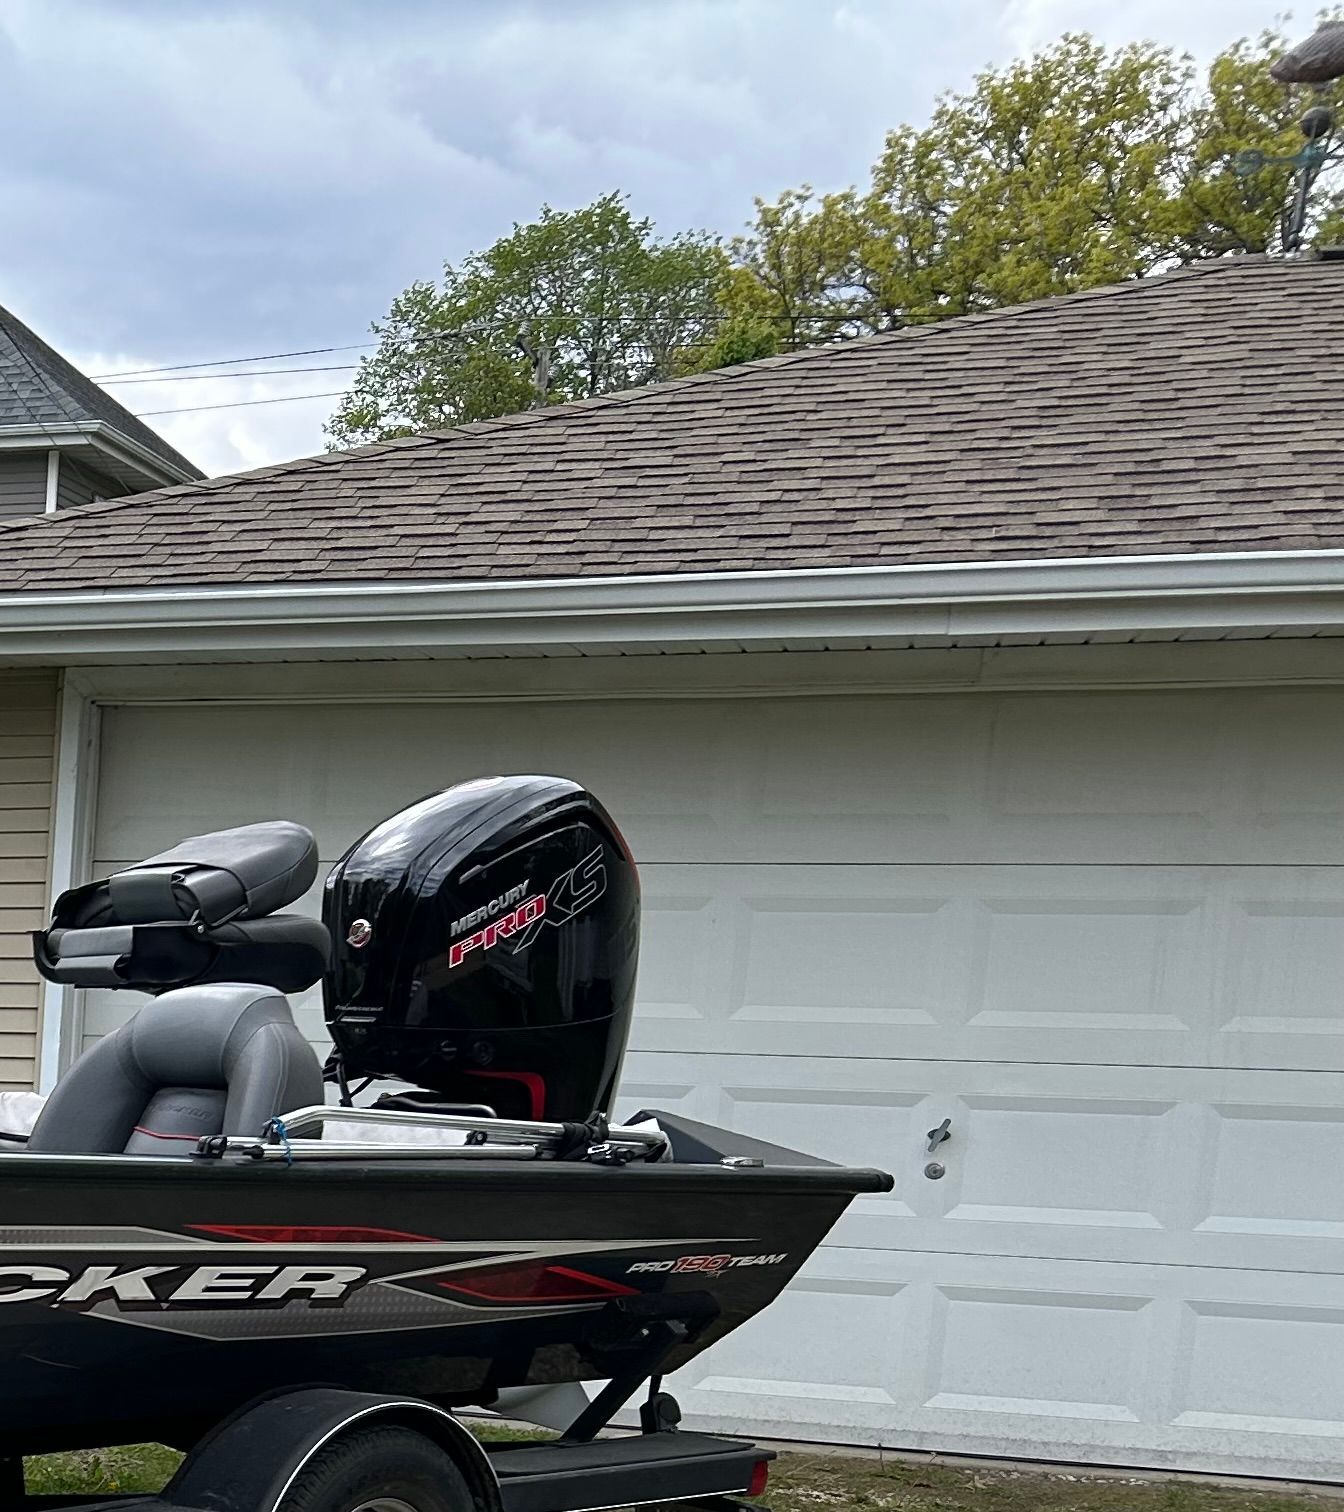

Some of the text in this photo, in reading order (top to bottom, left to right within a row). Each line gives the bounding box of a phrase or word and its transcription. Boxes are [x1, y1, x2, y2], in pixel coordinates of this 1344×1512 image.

[448, 843, 608, 969] PRO XS
[450, 878, 530, 937] MERCURY
[625, 1252, 789, 1274] PRO 190 TEAM
